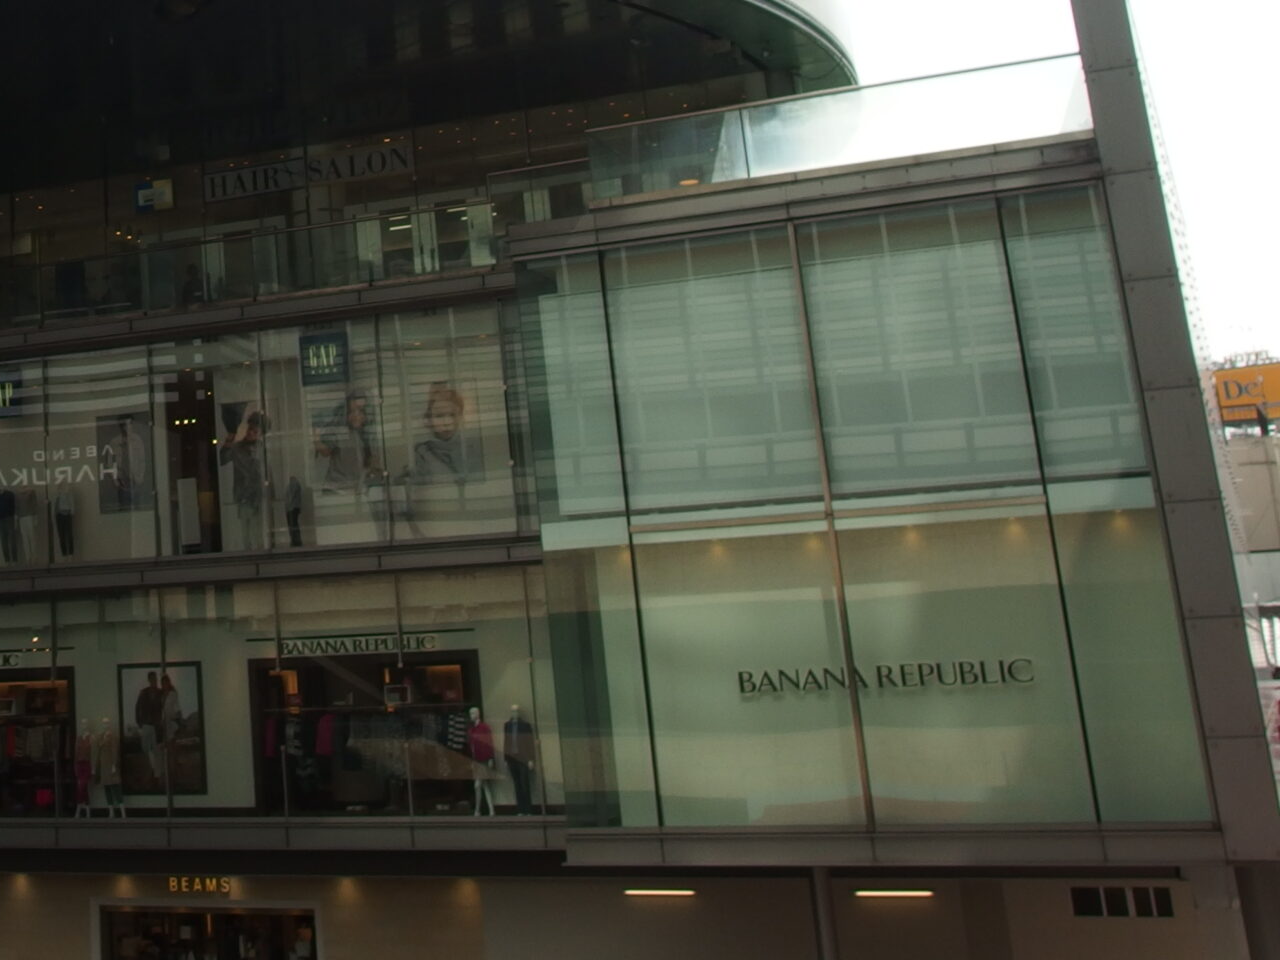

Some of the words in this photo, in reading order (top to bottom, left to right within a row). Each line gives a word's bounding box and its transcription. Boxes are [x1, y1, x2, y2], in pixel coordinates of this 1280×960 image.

[209, 168, 282, 199] HAIR
[308, 147, 410, 182] SALON
[308, 343, 337, 368] GAP
[278, 640, 349, 656] BANANA
[352, 634, 436, 652] REPUBLIC
[737, 665, 869, 695] BANANA
[876, 658, 1035, 690] REPUBLIC
[167, 875, 231, 894] BEAMS
